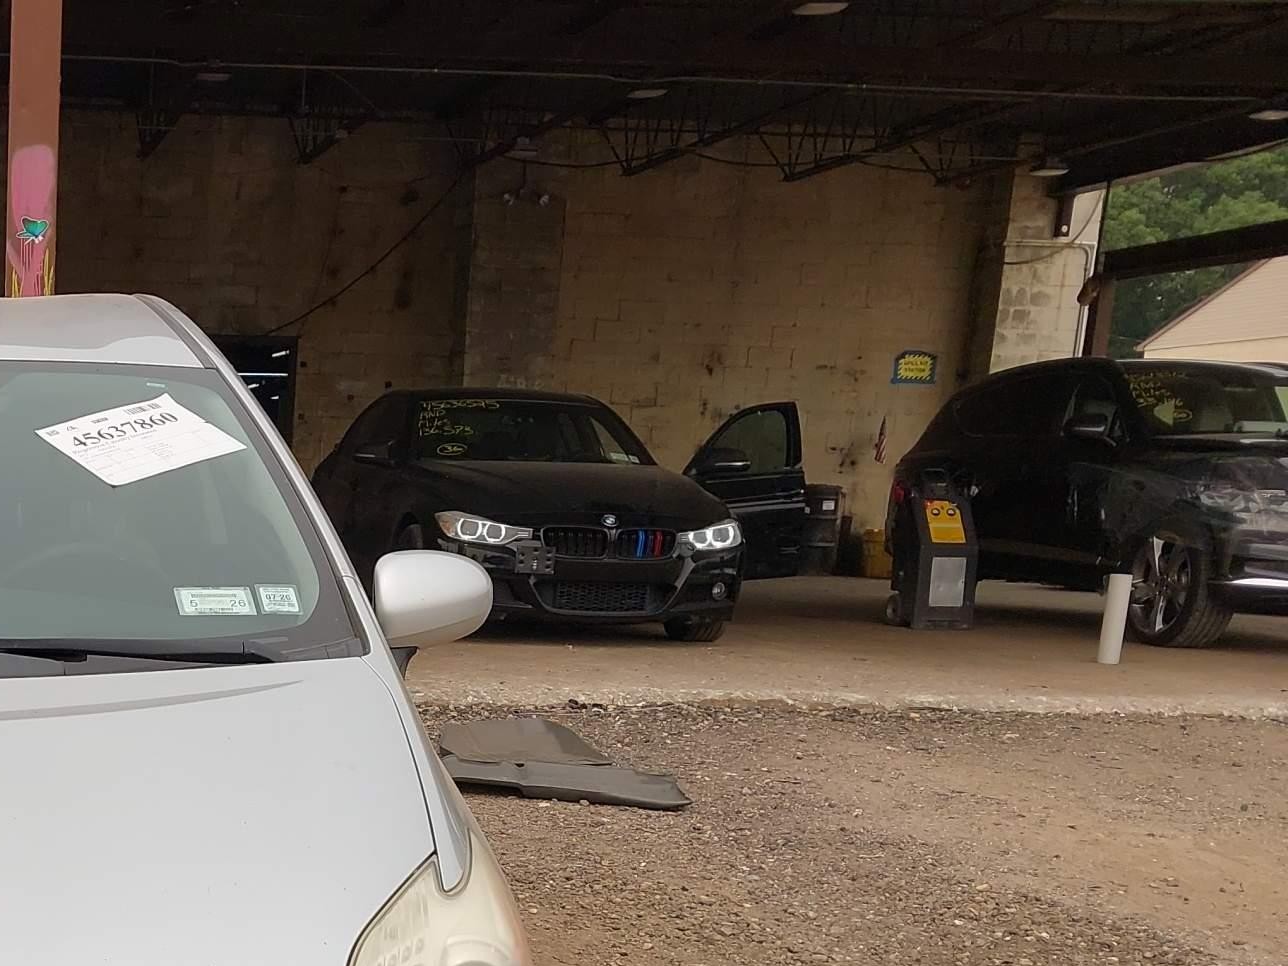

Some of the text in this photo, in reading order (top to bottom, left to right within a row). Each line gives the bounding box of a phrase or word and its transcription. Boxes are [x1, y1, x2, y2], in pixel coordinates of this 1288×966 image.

[71, 411, 179, 448] 45637860
[190, 599, 247, 608] 5 26
